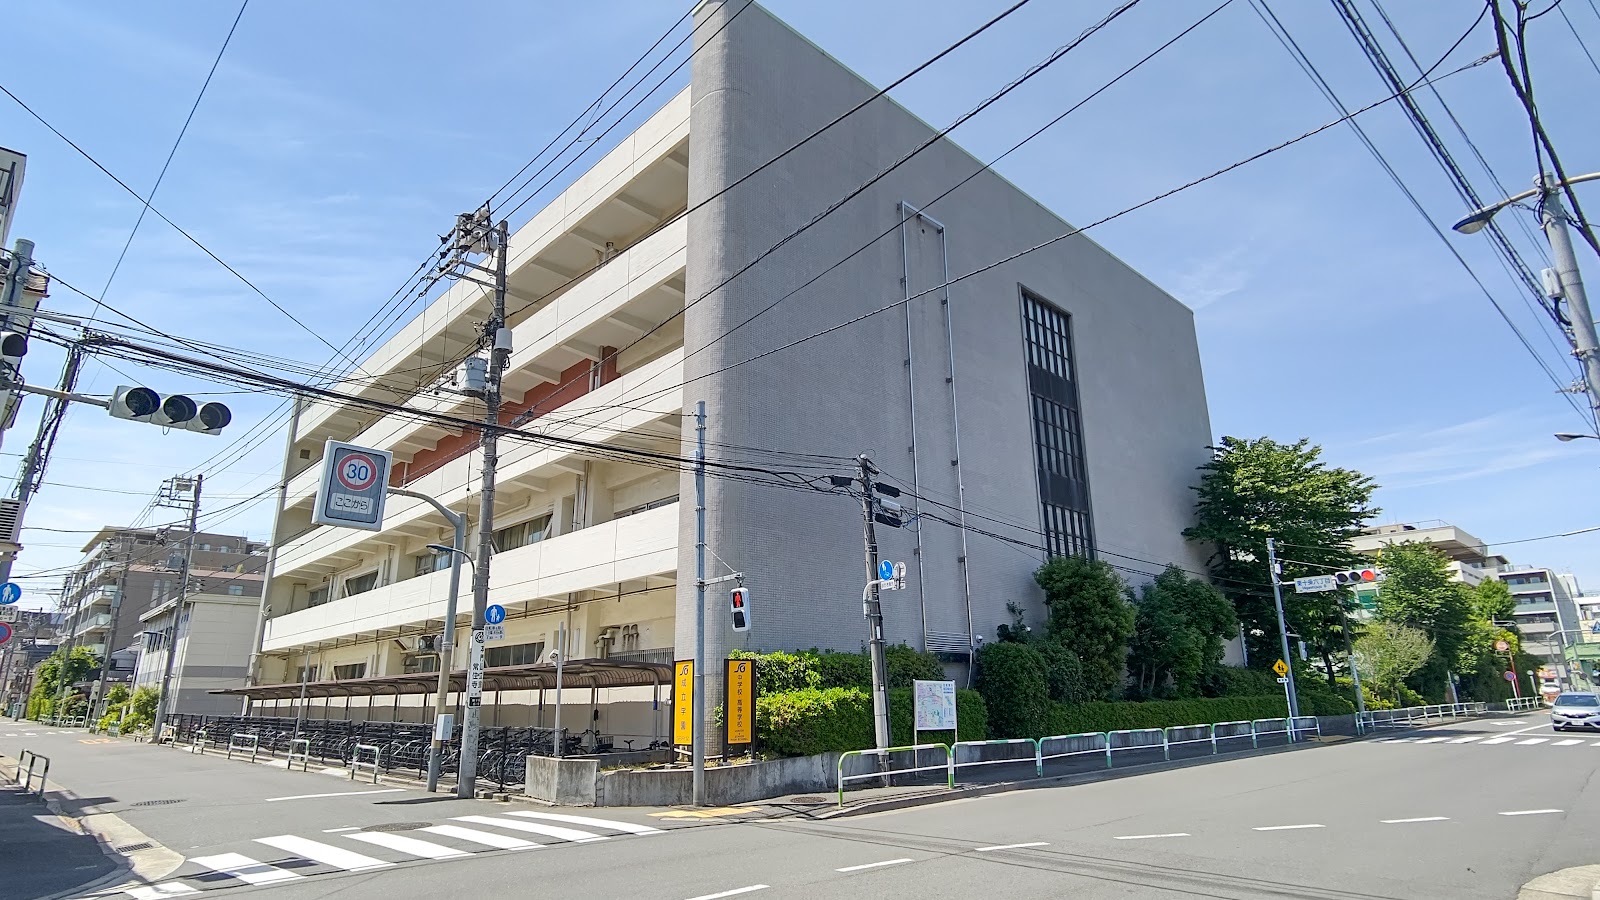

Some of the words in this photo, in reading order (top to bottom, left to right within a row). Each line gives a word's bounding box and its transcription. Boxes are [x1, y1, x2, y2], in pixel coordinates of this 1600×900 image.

[346, 463, 368, 481] 30
[335, 497, 368, 510] ここから
